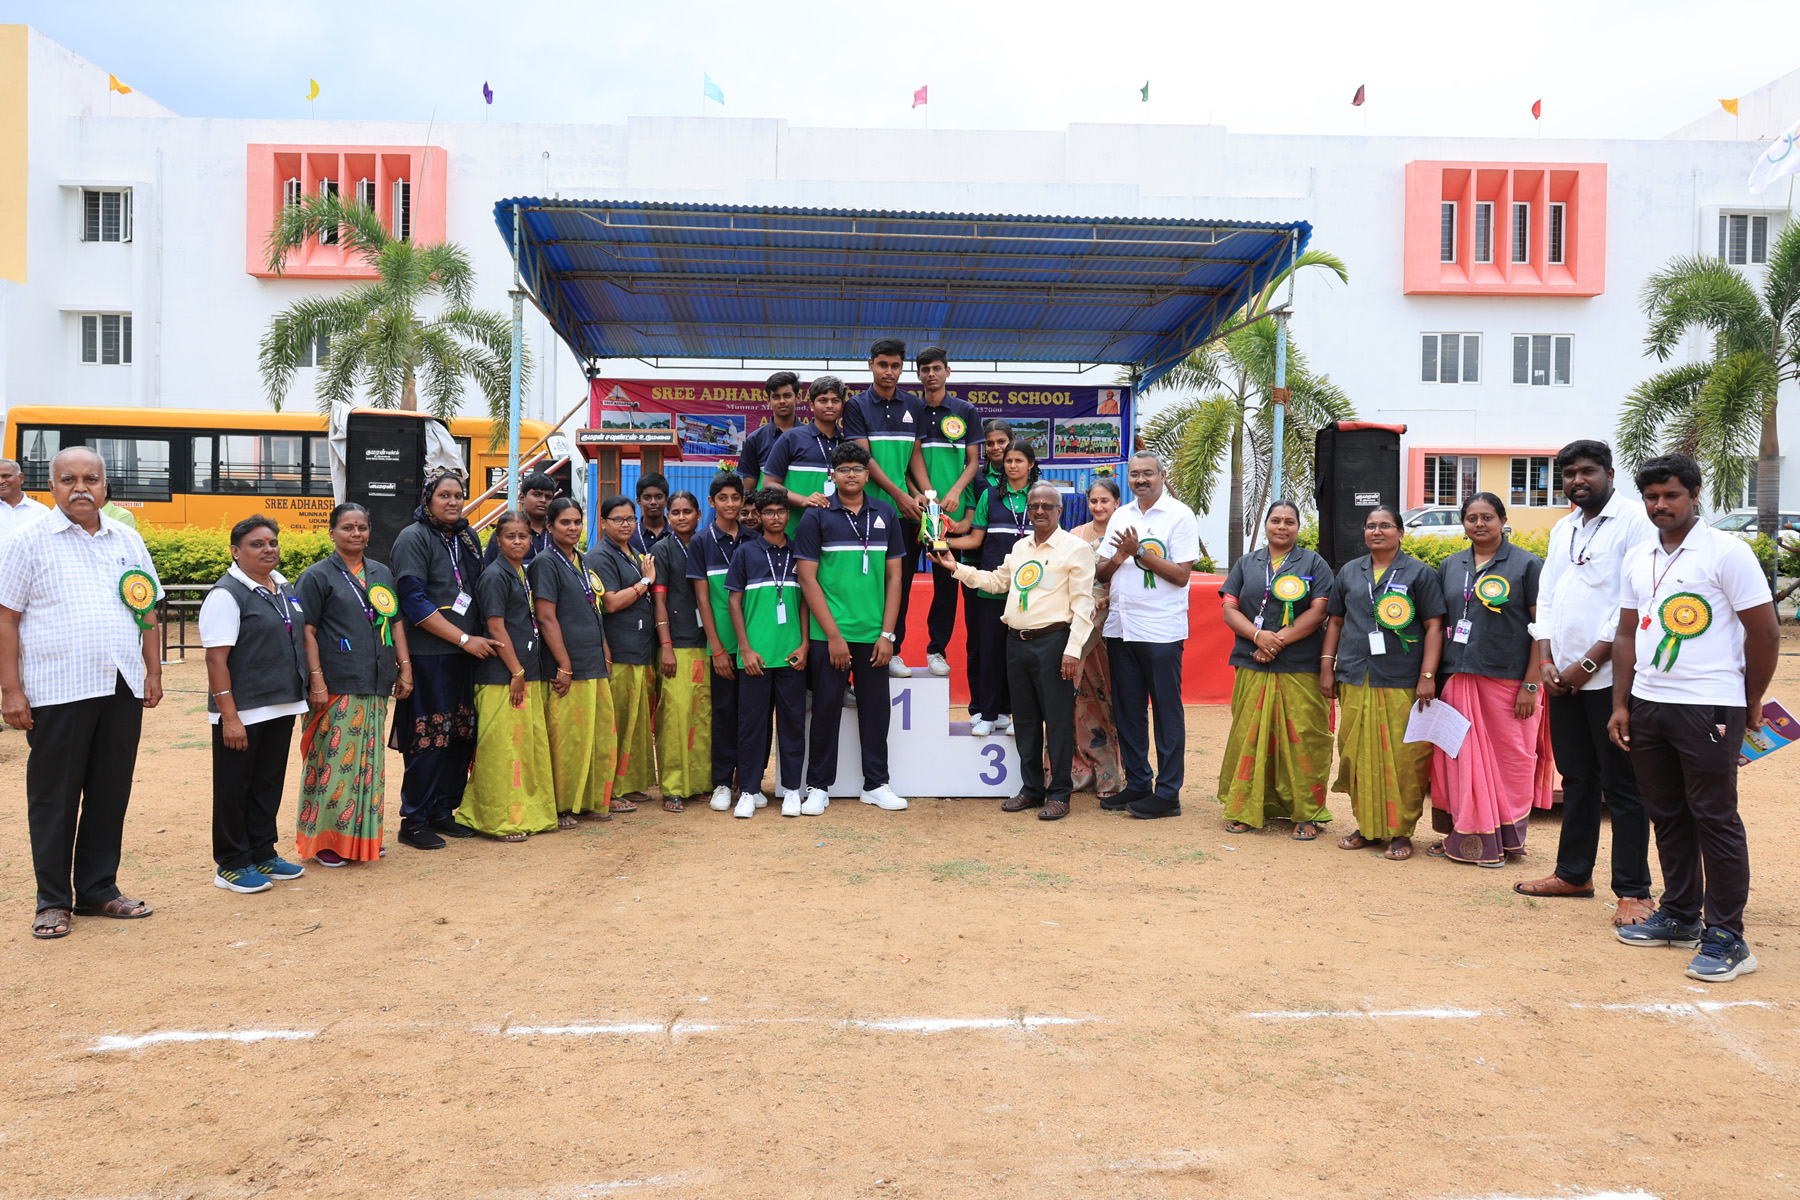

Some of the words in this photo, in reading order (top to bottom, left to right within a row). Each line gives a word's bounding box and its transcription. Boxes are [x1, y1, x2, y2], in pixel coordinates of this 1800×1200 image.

[651, 386, 696, 401] SREE
[700, 387, 770, 402] ADHARS
[967, 390, 1004, 405] SEC.
[1007, 391, 1075, 406] SCHOOL
[725, 403, 759, 411] Munnar
[265, 498, 289, 509] SREE
[891, 688, 912, 731] 1
[979, 743, 1008, 786] 3
